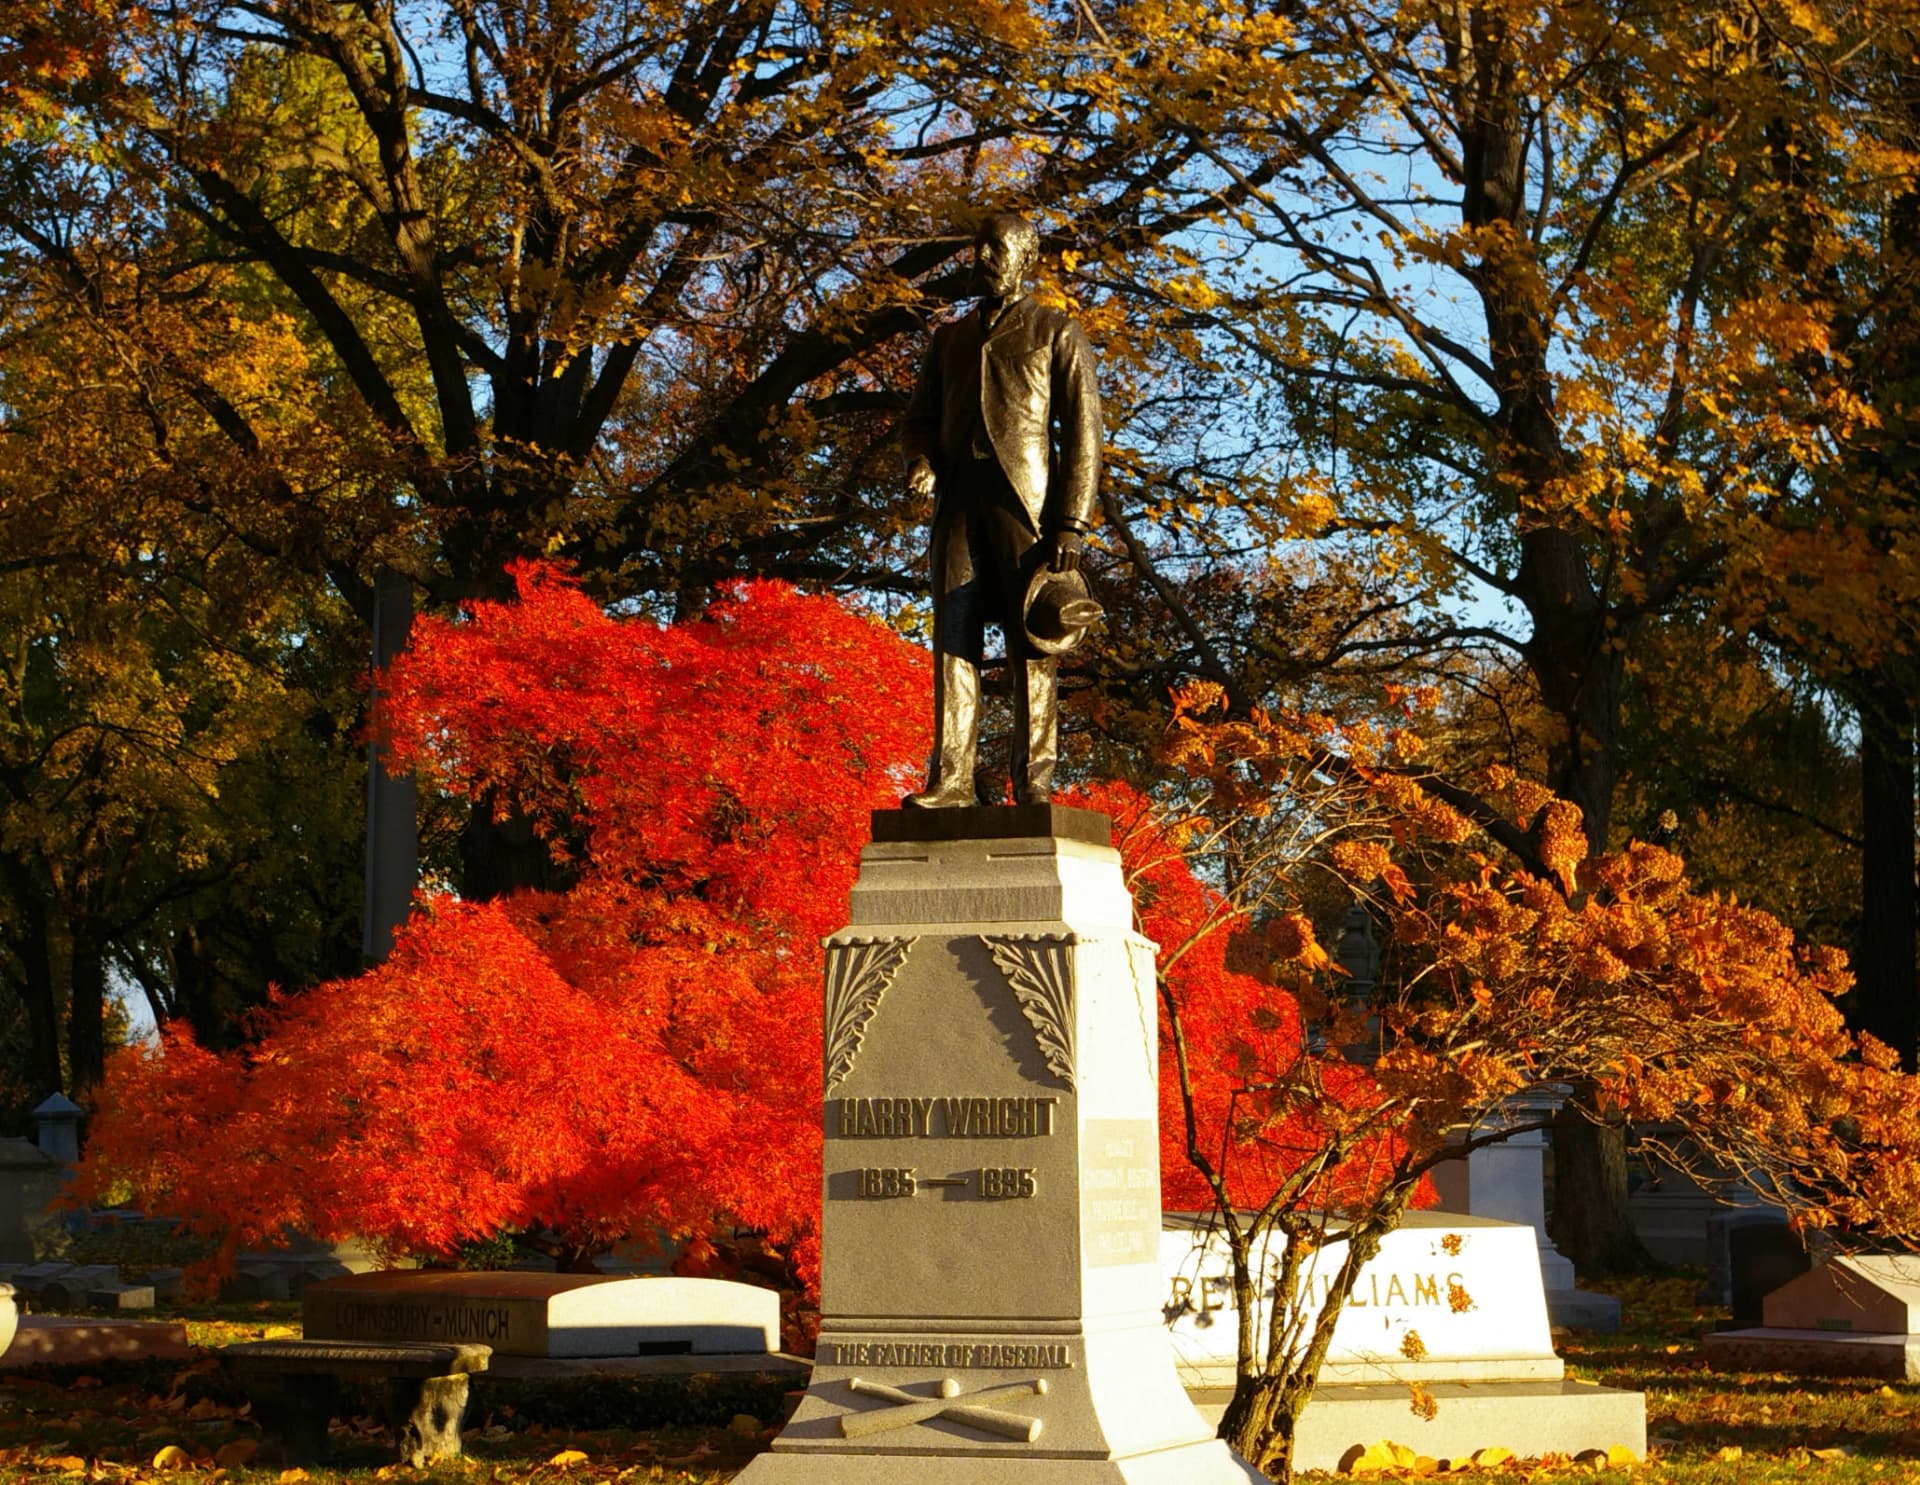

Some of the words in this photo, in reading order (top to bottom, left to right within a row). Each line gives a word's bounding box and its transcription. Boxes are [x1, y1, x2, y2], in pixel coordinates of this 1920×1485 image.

[840, 1097, 935, 1136] HARRY
[944, 1097, 1060, 1137] WRIGHT
[859, 1167, 917, 1198] 1835
[979, 1167, 1037, 1198] 1895
[833, 1343, 869, 1366] THE
[872, 1343, 947, 1367] FATHER
[950, 1344, 976, 1368] OF
[979, 1344, 1075, 1369] BASEBALL
